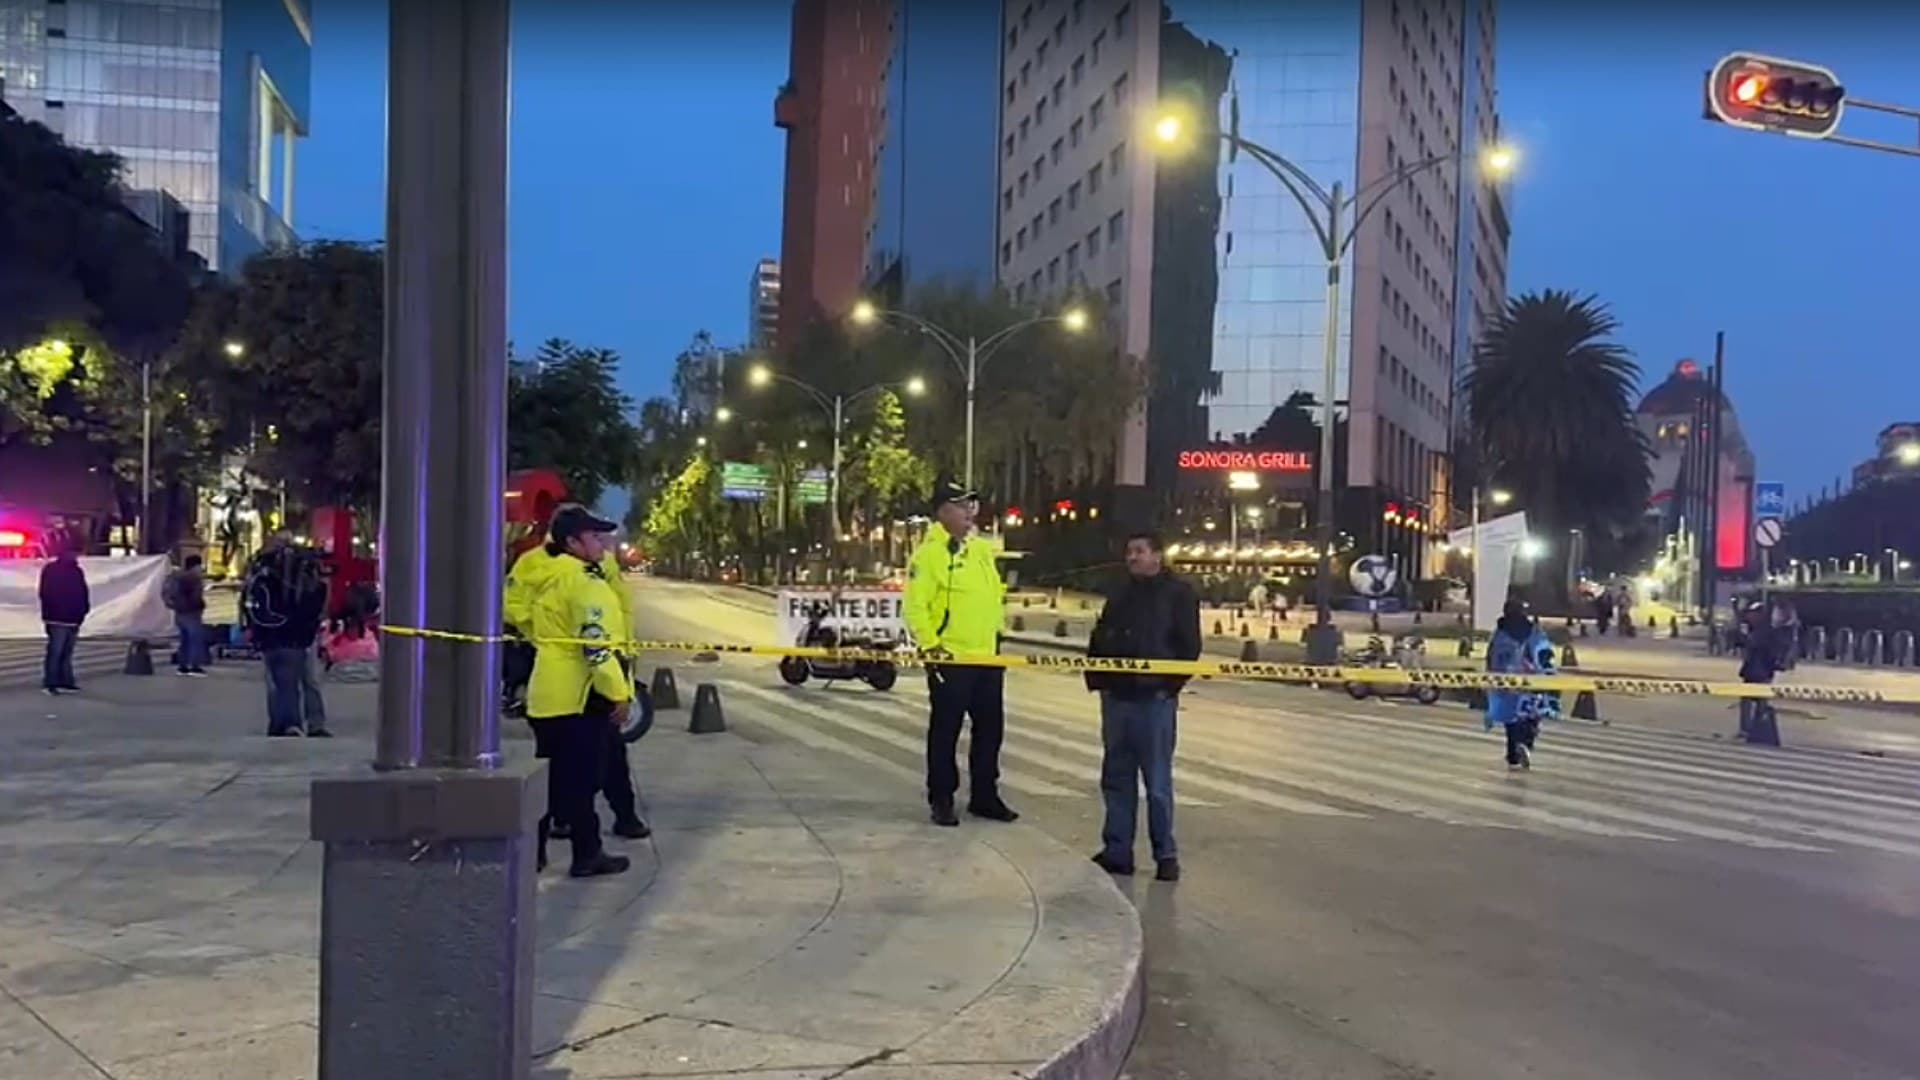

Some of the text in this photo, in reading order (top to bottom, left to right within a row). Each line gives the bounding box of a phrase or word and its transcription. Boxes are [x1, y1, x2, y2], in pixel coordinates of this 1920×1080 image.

[1178, 451, 1312, 469] SONORA GRILL
[866, 598, 891, 618] DE
